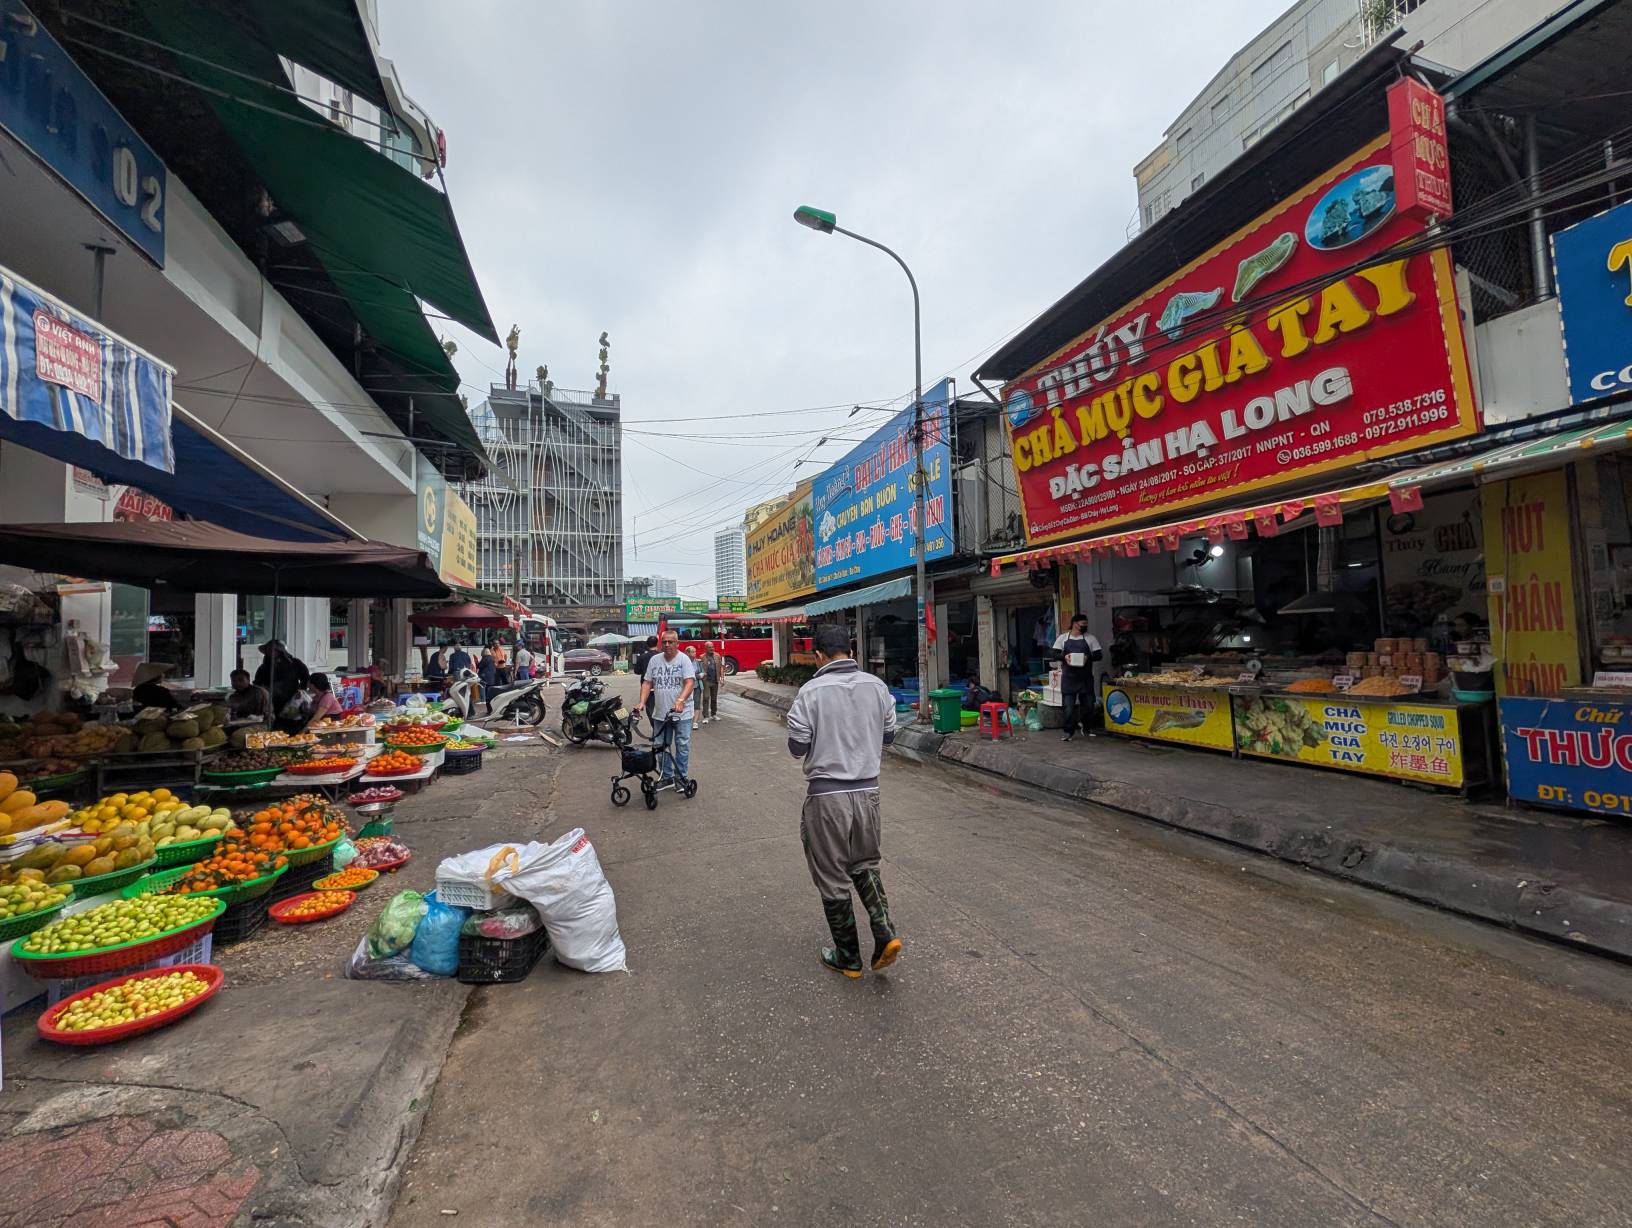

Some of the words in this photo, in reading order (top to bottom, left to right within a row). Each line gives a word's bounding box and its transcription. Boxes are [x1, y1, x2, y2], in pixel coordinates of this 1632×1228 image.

[1014, 407, 1078, 472] CHẢ
[1076, 371, 1165, 446] MỰC
[1267, 257, 1417, 359] TAY
[1036, 312, 1151, 410] THÚY
[1363, 388, 1446, 425] 079.538.7316
[1049, 463, 1101, 500] ĐẶC
[1102, 437, 1165, 481] SẢN
[1165, 420, 1219, 459] HẠ
[1221, 367, 1354, 441] LONG
[1218, 446, 1252, 467] 37/2017
[1256, 431, 1294, 454] NNPNT
[1310, 420, 1331, 436] QN
[1293, 431, 1359, 460] 036.599.1688
[1365, 405, 1448, 440] 0972.911.996
[1324, 720, 1366, 734] MỰC
[1387, 711, 1406, 726] GRILLED
[1407, 712, 1429, 728] CHOPPED
[1429, 714, 1445, 729] SQUID
[1330, 735, 1361, 748] GIÃ
[1379, 732, 1398, 748] 다진
[1402, 734, 1431, 752] 오징어
[1435, 736, 1456, 756] 구이
[1329, 749, 1365, 763] TAY
[1390, 752, 1452, 776] 炸墨鱼
[1537, 784, 1573, 803] ĐT:
